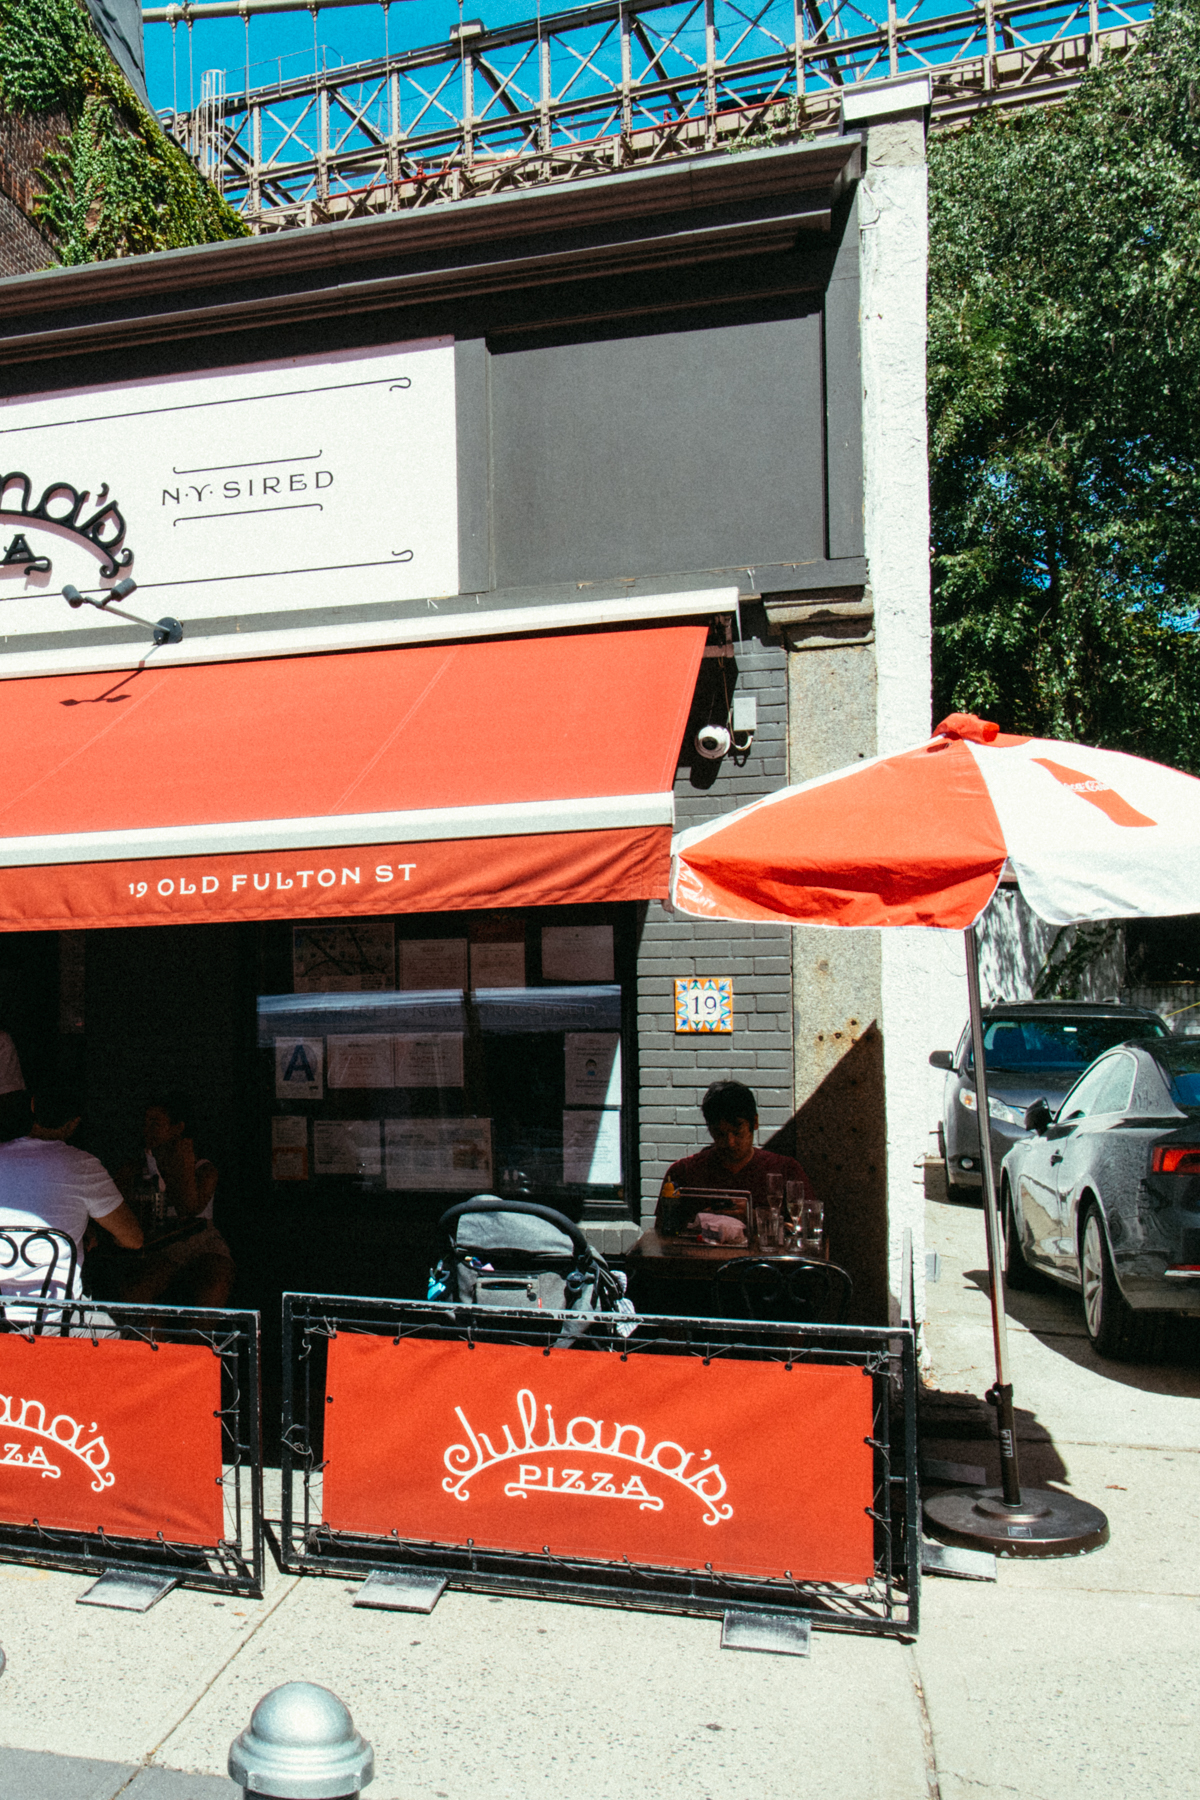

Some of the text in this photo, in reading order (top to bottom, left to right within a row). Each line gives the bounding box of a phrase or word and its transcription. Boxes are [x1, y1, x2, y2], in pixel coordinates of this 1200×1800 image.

[222, 470, 335, 499] SIRED
[128, 863, 417, 898] 19 OLD FULTON ST
[691, 995, 717, 1016] 19
[282, 1044, 317, 1082] A
[442, 1388, 733, 1527] Juliana's
[517, 1463, 649, 1498] PIZZA
